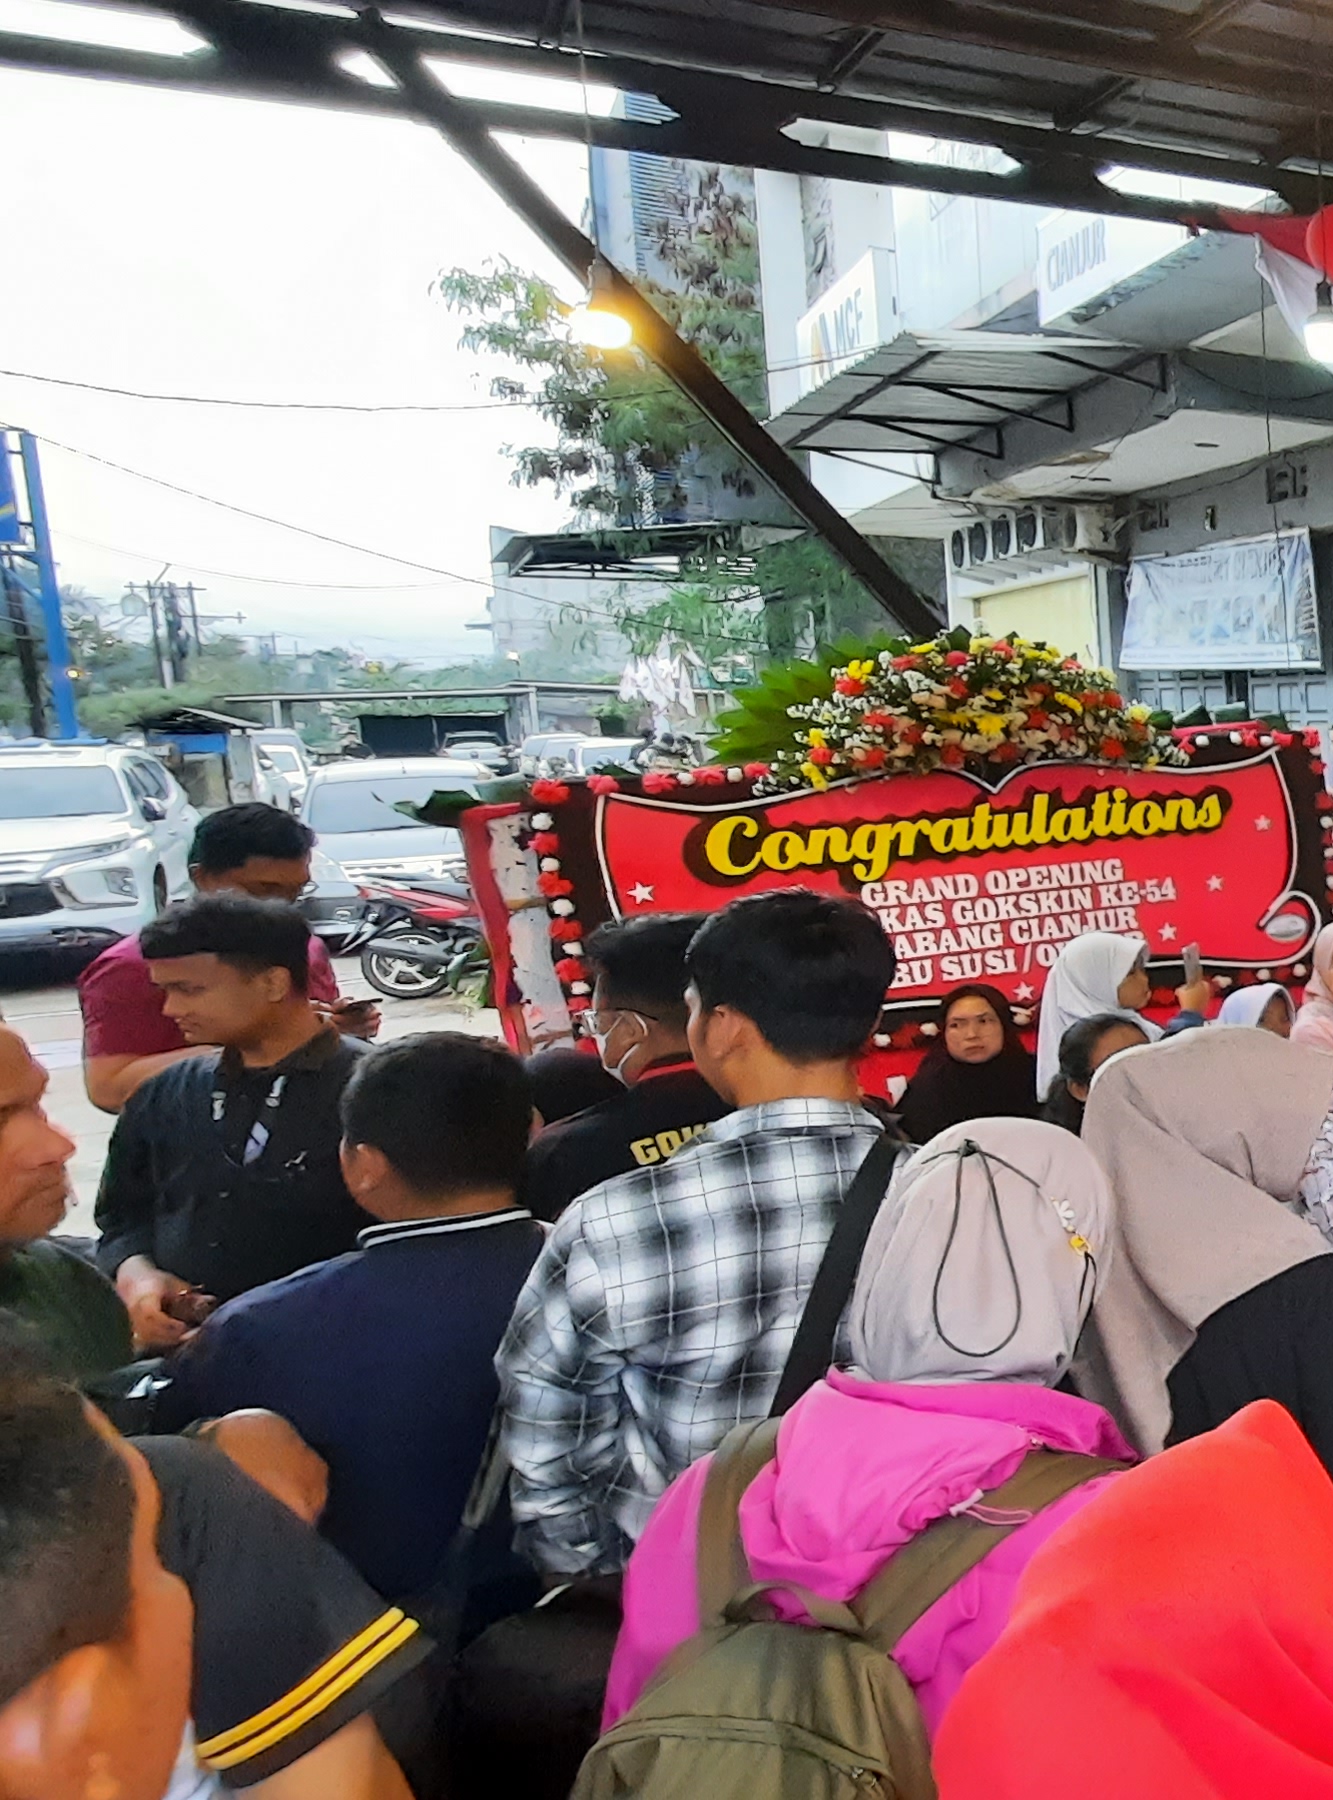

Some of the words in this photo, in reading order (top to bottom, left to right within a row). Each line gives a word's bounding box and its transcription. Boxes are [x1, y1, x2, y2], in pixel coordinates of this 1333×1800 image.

[1047, 217, 1108, 291] CIANJUR
[705, 788, 1221, 881] Congratulations
[861, 873, 979, 907] GRAND
[985, 858, 1124, 896] OPENING
[879, 903, 946, 934] KAS
[952, 886, 1093, 926] GOKSKIN
[1097, 876, 1177, 907] KE-54
[894, 922, 1003, 960] ABANG
[1010, 906, 1139, 945] CIANJUR
[889, 958, 933, 990] BU
[940, 948, 1018, 982] SUSI
